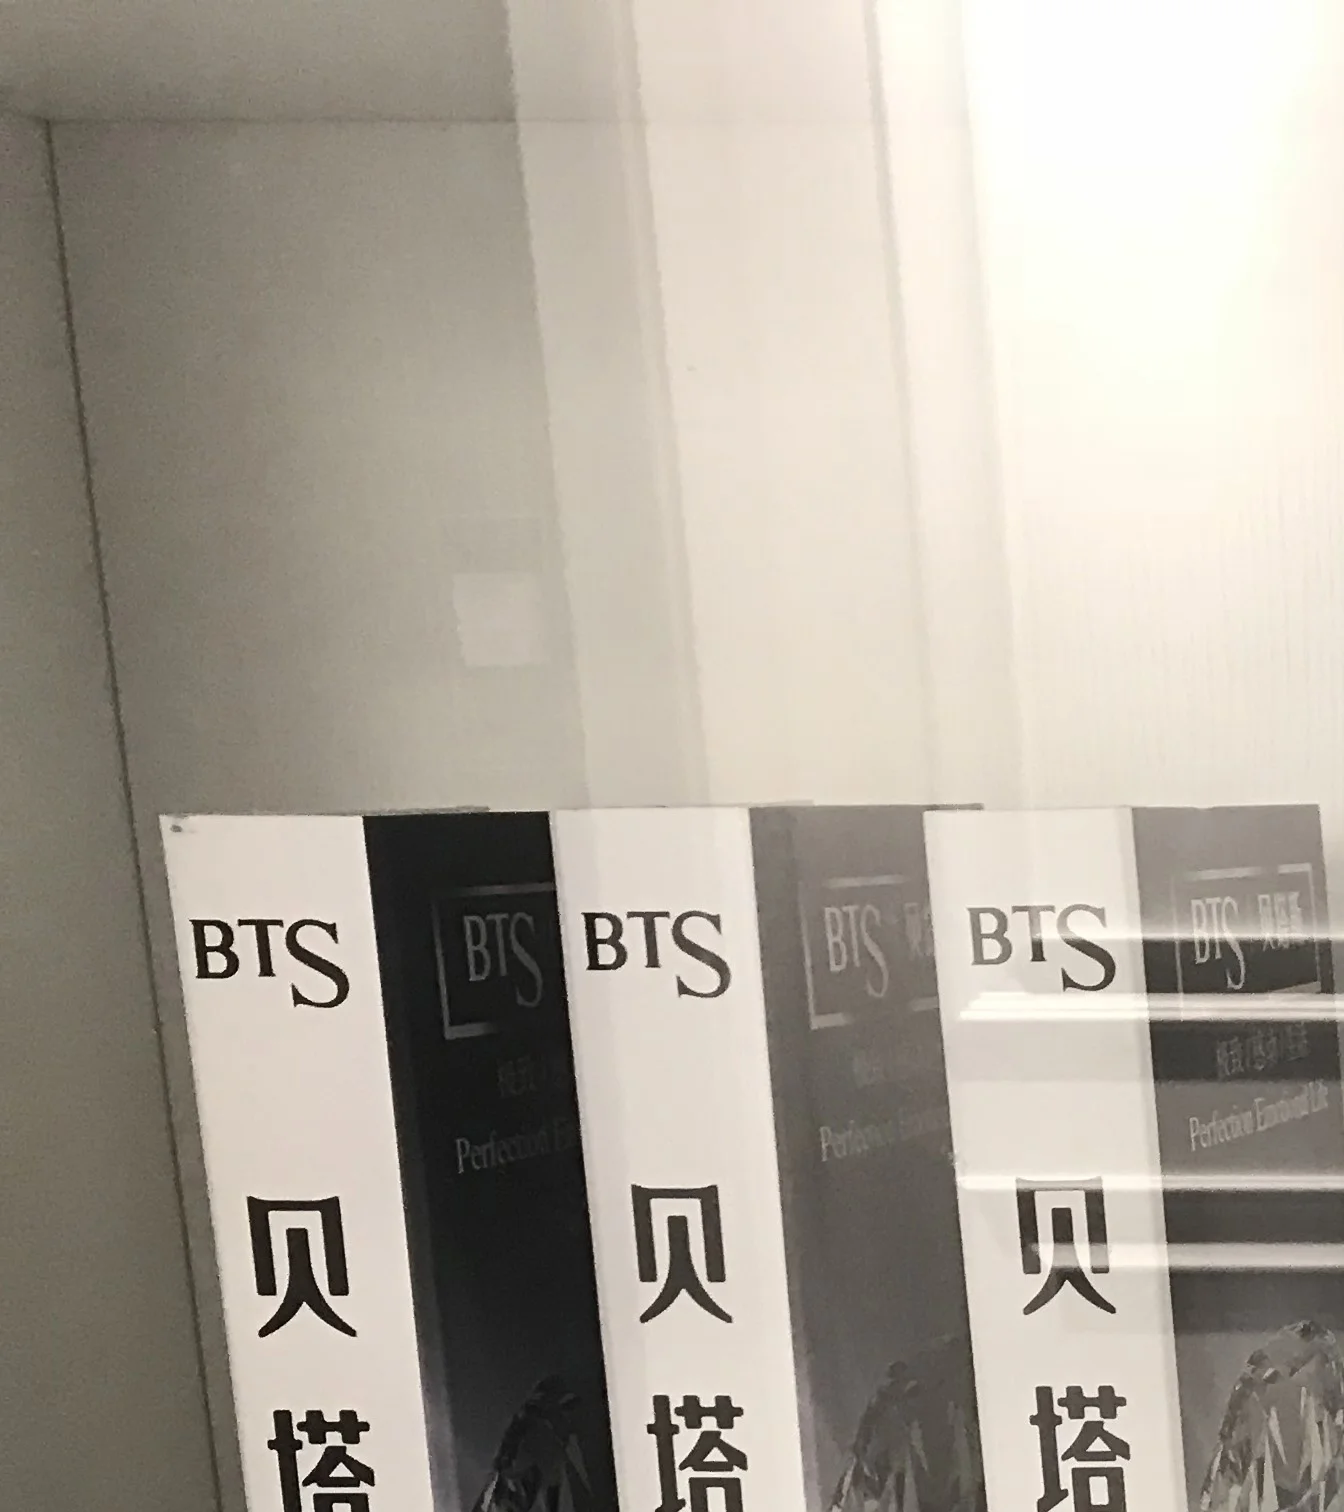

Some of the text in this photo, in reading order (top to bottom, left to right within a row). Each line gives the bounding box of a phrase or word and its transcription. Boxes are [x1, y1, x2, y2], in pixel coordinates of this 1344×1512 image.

[189, 918, 350, 1008] BTS
[462, 911, 545, 1008] BTS
[581, 909, 732, 998] BTS
[823, 903, 889, 998] BTS
[966, 903, 1117, 992] BTS
[1190, 896, 1246, 990] BTS
